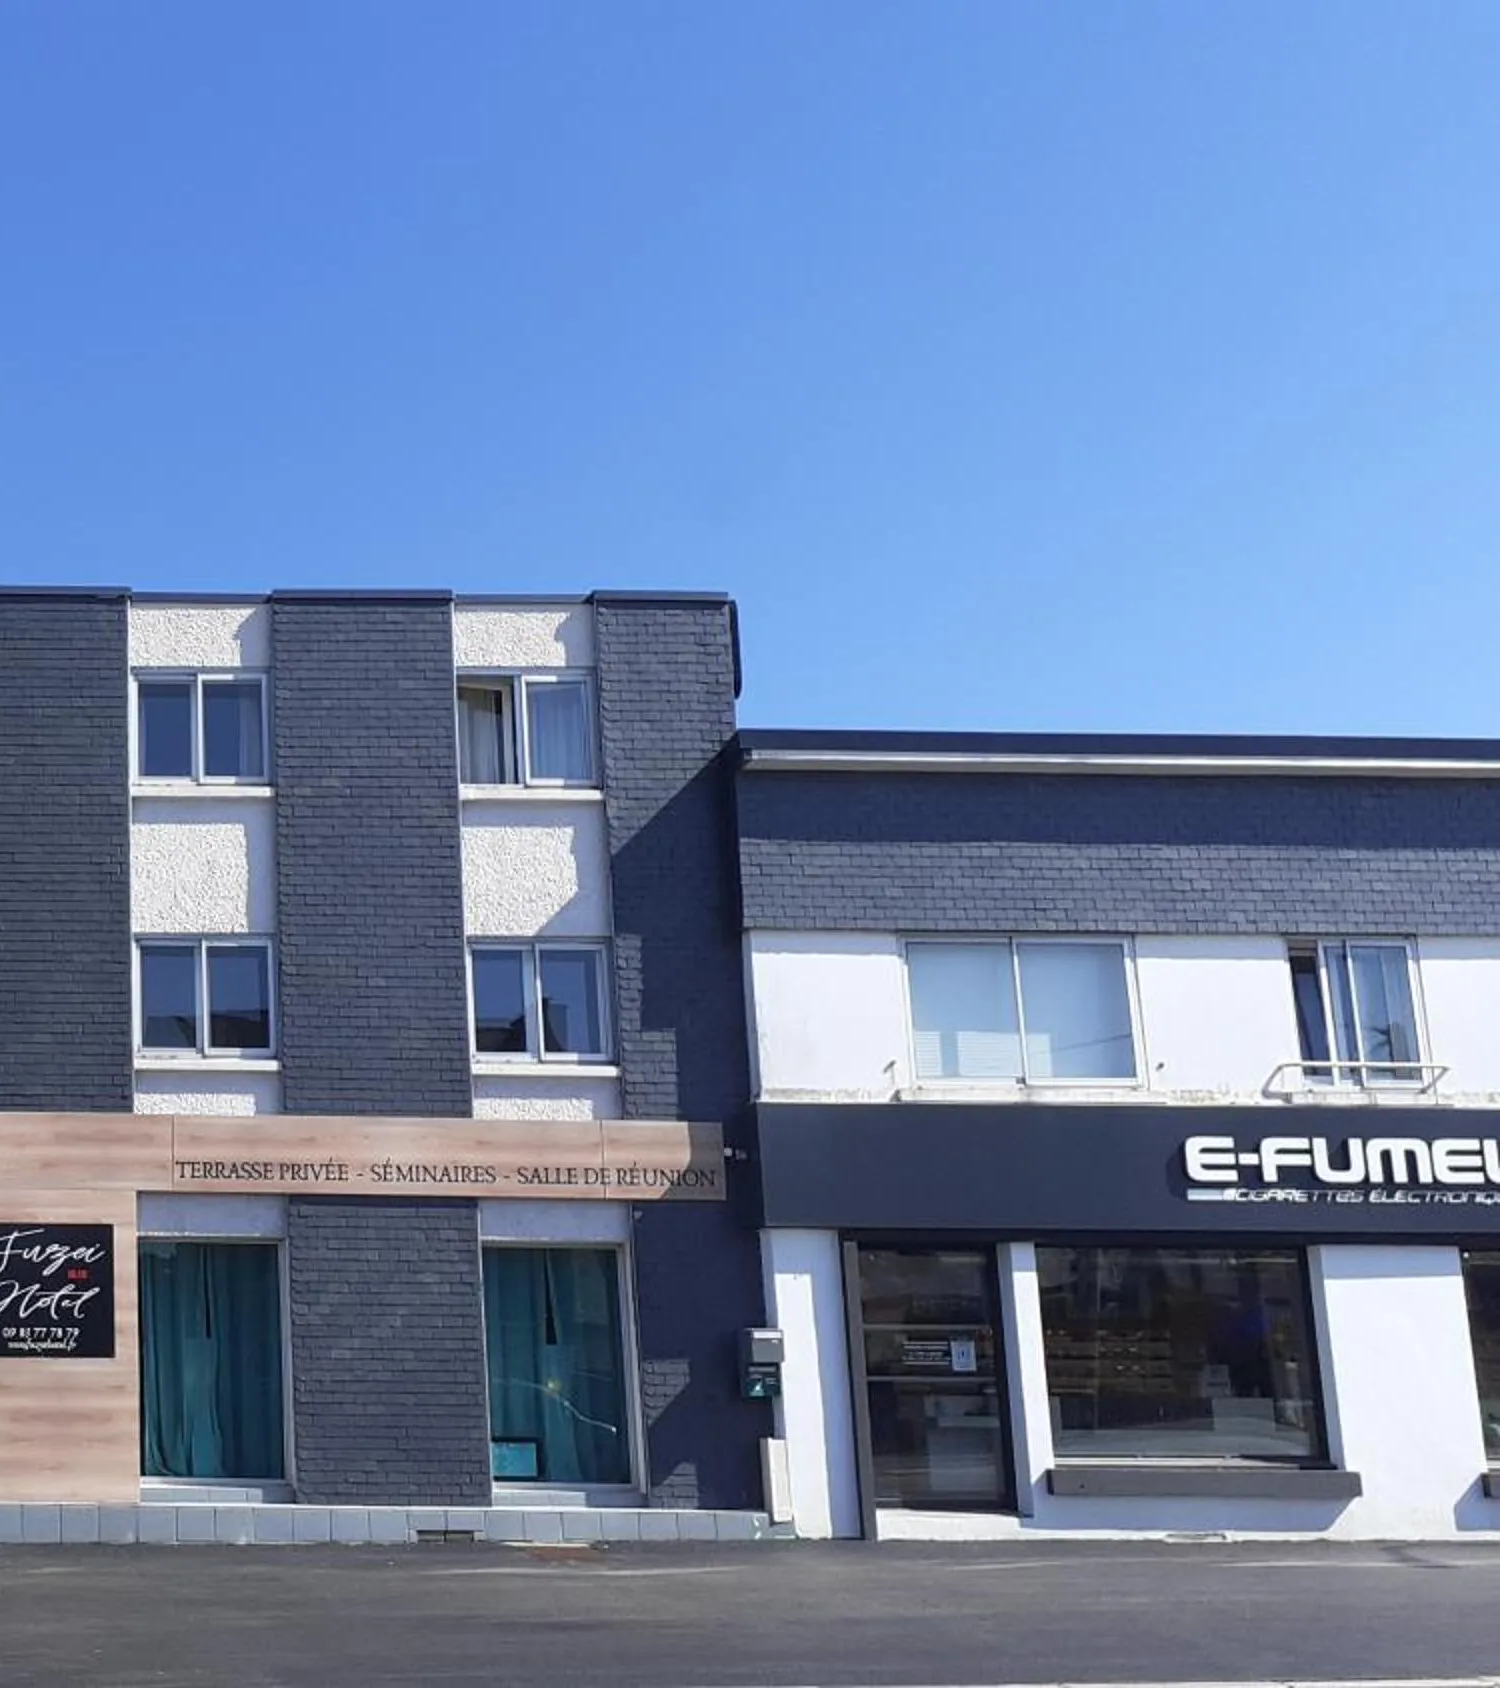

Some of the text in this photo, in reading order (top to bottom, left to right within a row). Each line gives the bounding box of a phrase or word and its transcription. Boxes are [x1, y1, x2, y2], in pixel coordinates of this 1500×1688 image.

[176, 1160, 275, 1180] TERRASSE
[279, 1157, 349, 1182] PRIVÉE
[370, 1157, 497, 1184] SÉMINAIRES
[516, 1166, 579, 1186] SALLE
[584, 1167, 611, 1187] DE
[617, 1161, 715, 1188] RÉUNION
